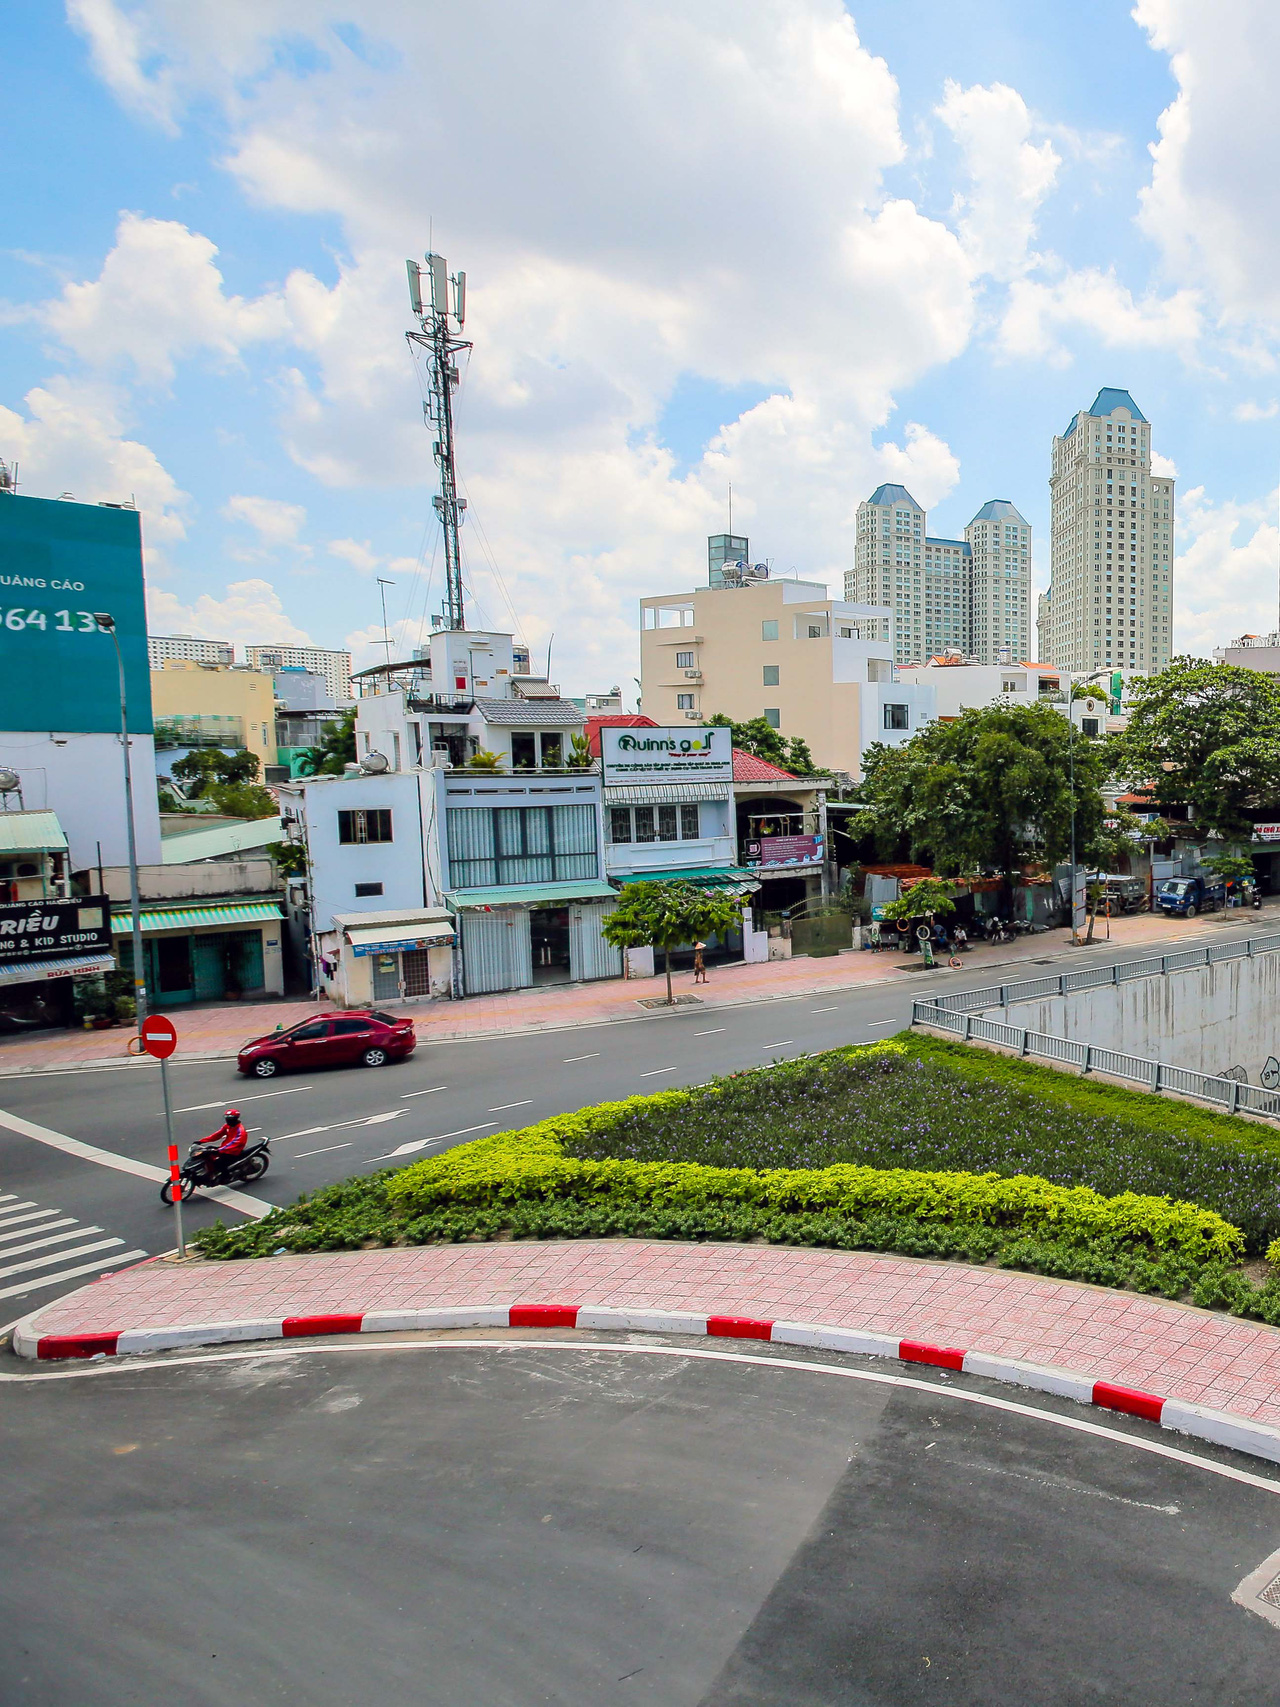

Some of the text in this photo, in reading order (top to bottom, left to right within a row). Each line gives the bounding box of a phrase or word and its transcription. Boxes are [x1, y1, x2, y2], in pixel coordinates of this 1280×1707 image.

[0, 607, 47, 631] 64
[20, 939, 30, 948] &
[35, 937, 54, 946] KID
[60, 932, 98, 944] STUDIO
